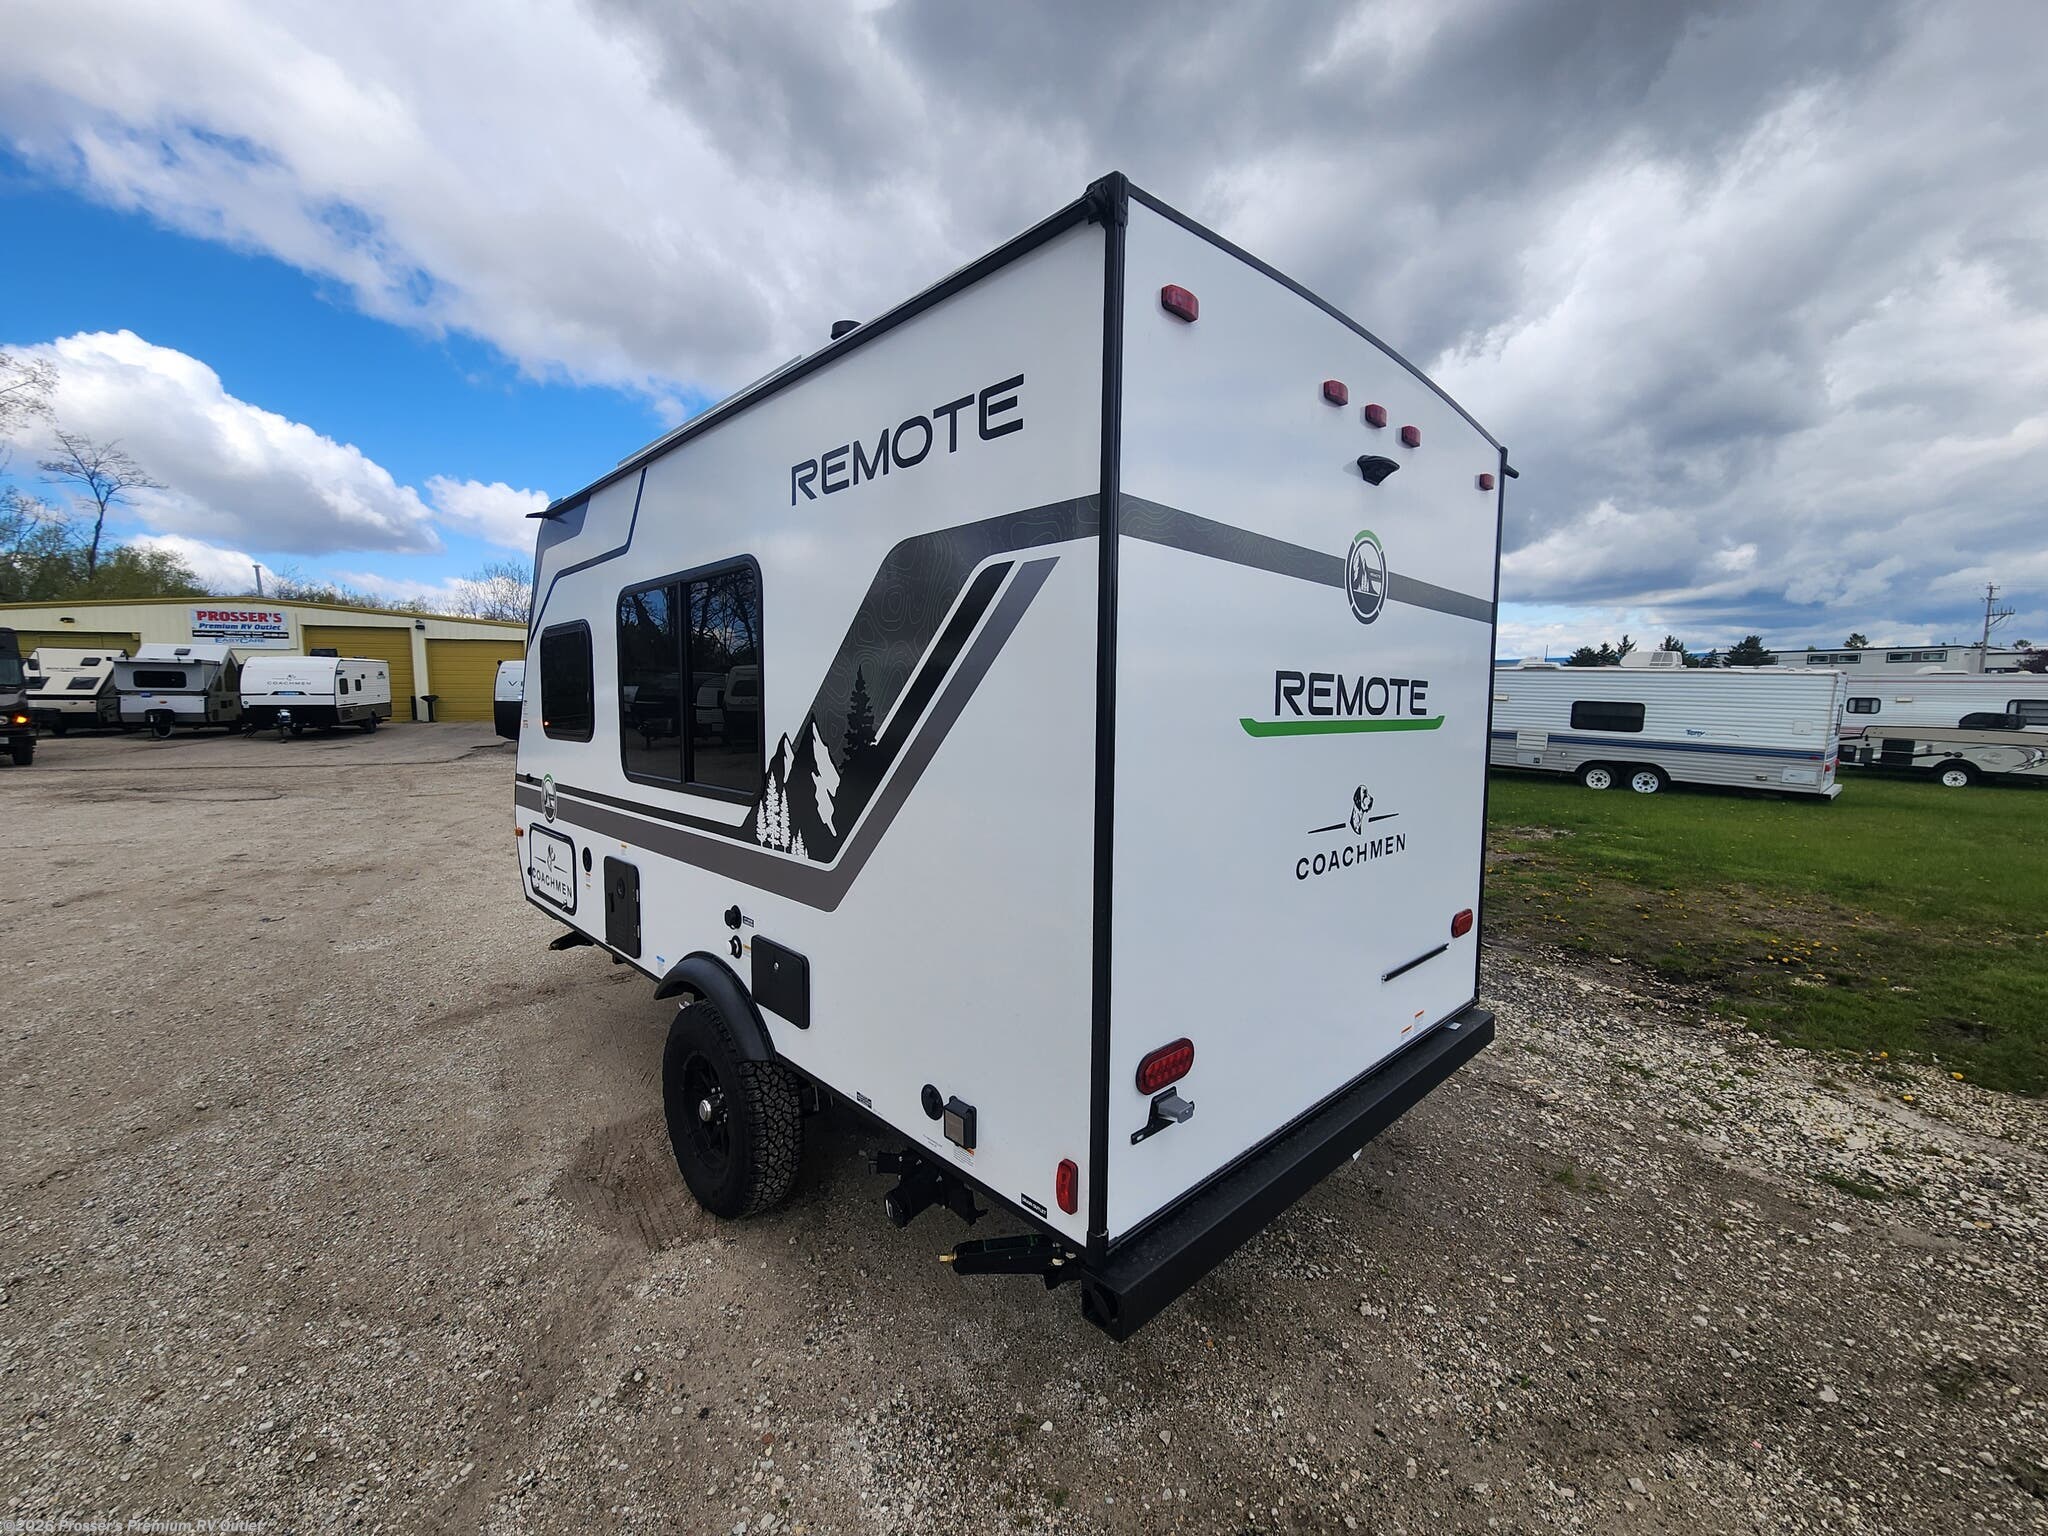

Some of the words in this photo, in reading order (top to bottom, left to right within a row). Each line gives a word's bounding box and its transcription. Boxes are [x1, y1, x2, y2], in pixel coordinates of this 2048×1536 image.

[791, 373, 1024, 506] REMOTE
[196, 611, 282, 623] PROSSER'S
[1274, 670, 1429, 716] REMOTE
[1295, 832, 1406, 880] COACHMEN
[531, 867, 573, 899] COACHMEN
